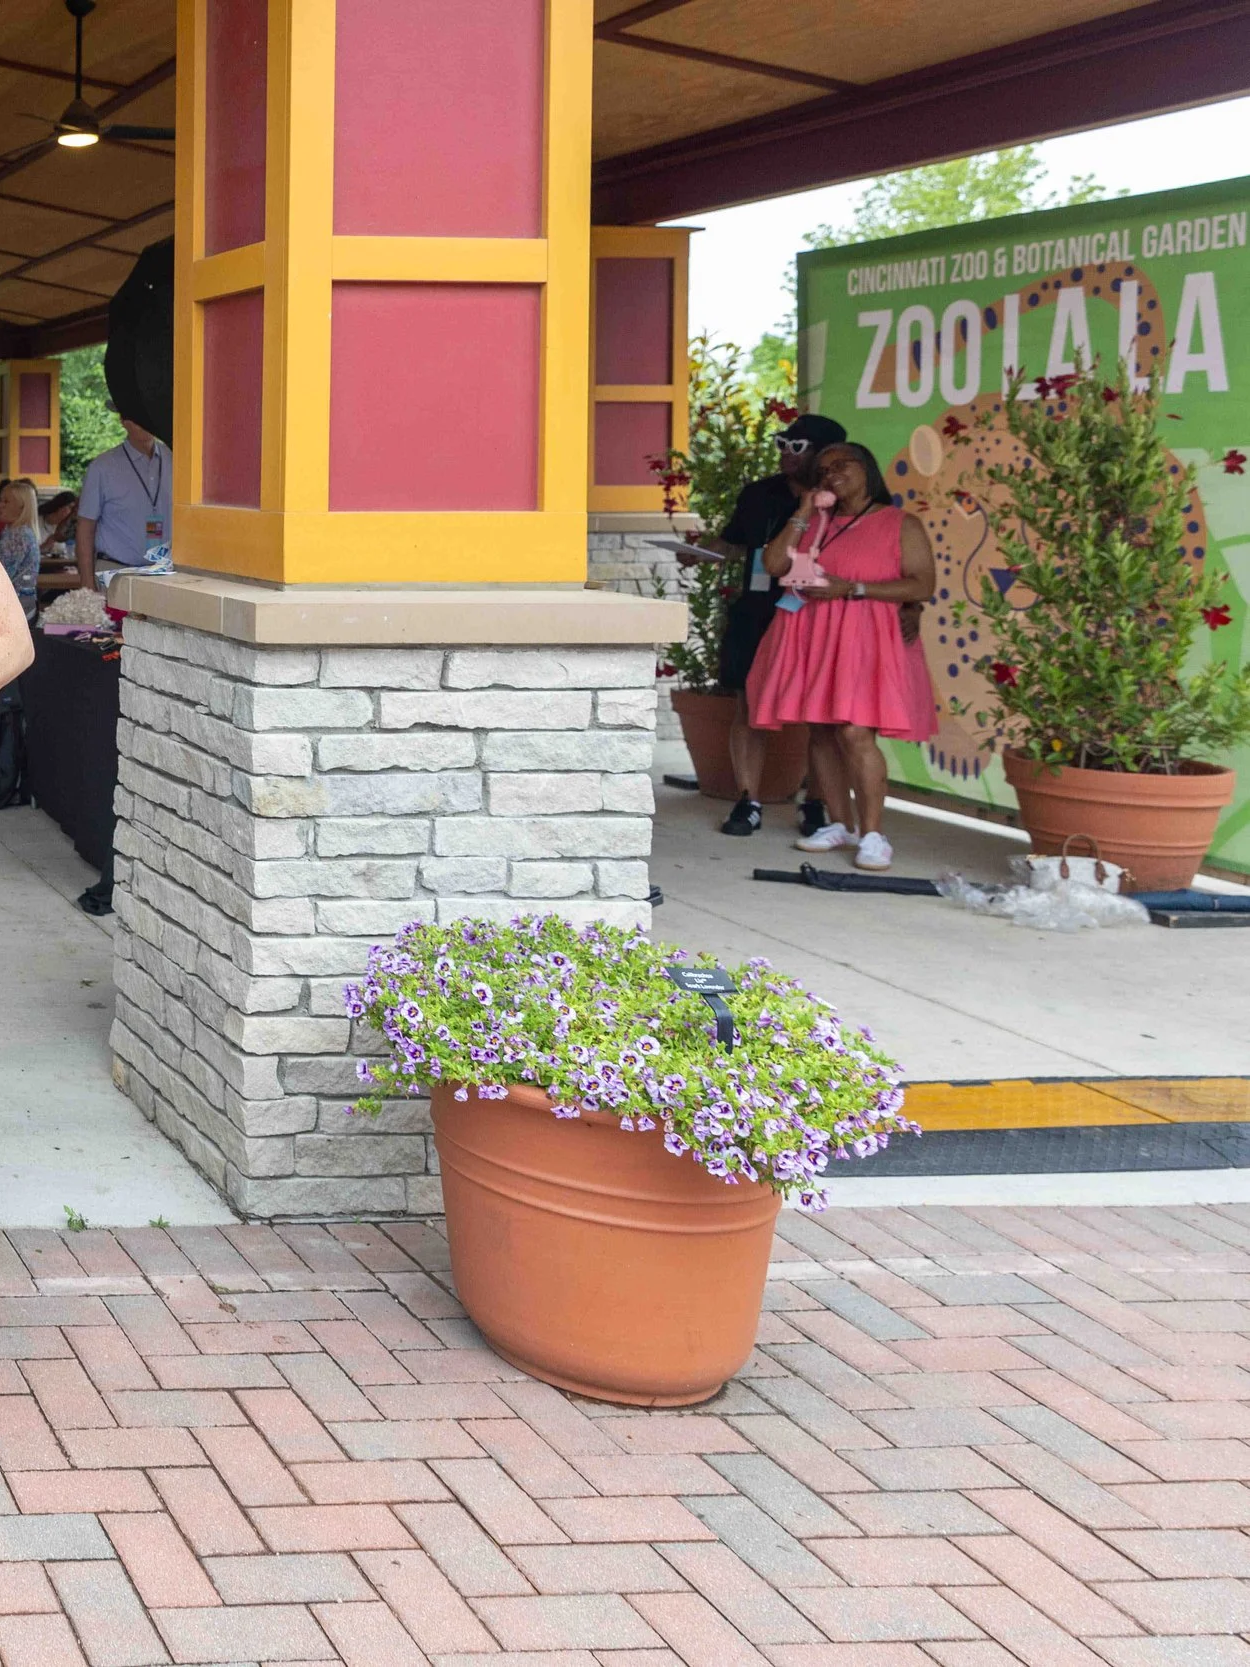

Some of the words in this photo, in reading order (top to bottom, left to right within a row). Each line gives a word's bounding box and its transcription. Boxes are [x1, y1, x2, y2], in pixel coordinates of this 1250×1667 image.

[848, 258, 946, 296] CINCINNATI
[950, 250, 989, 283] ZOO
[993, 247, 1009, 279] &
[1012, 229, 1135, 276] BOTANICAL
[1141, 211, 1248, 260] GARDEN
[855, 299, 983, 410] ZOO
[1002, 286, 1093, 402] LA
[1119, 271, 1230, 396] LA
